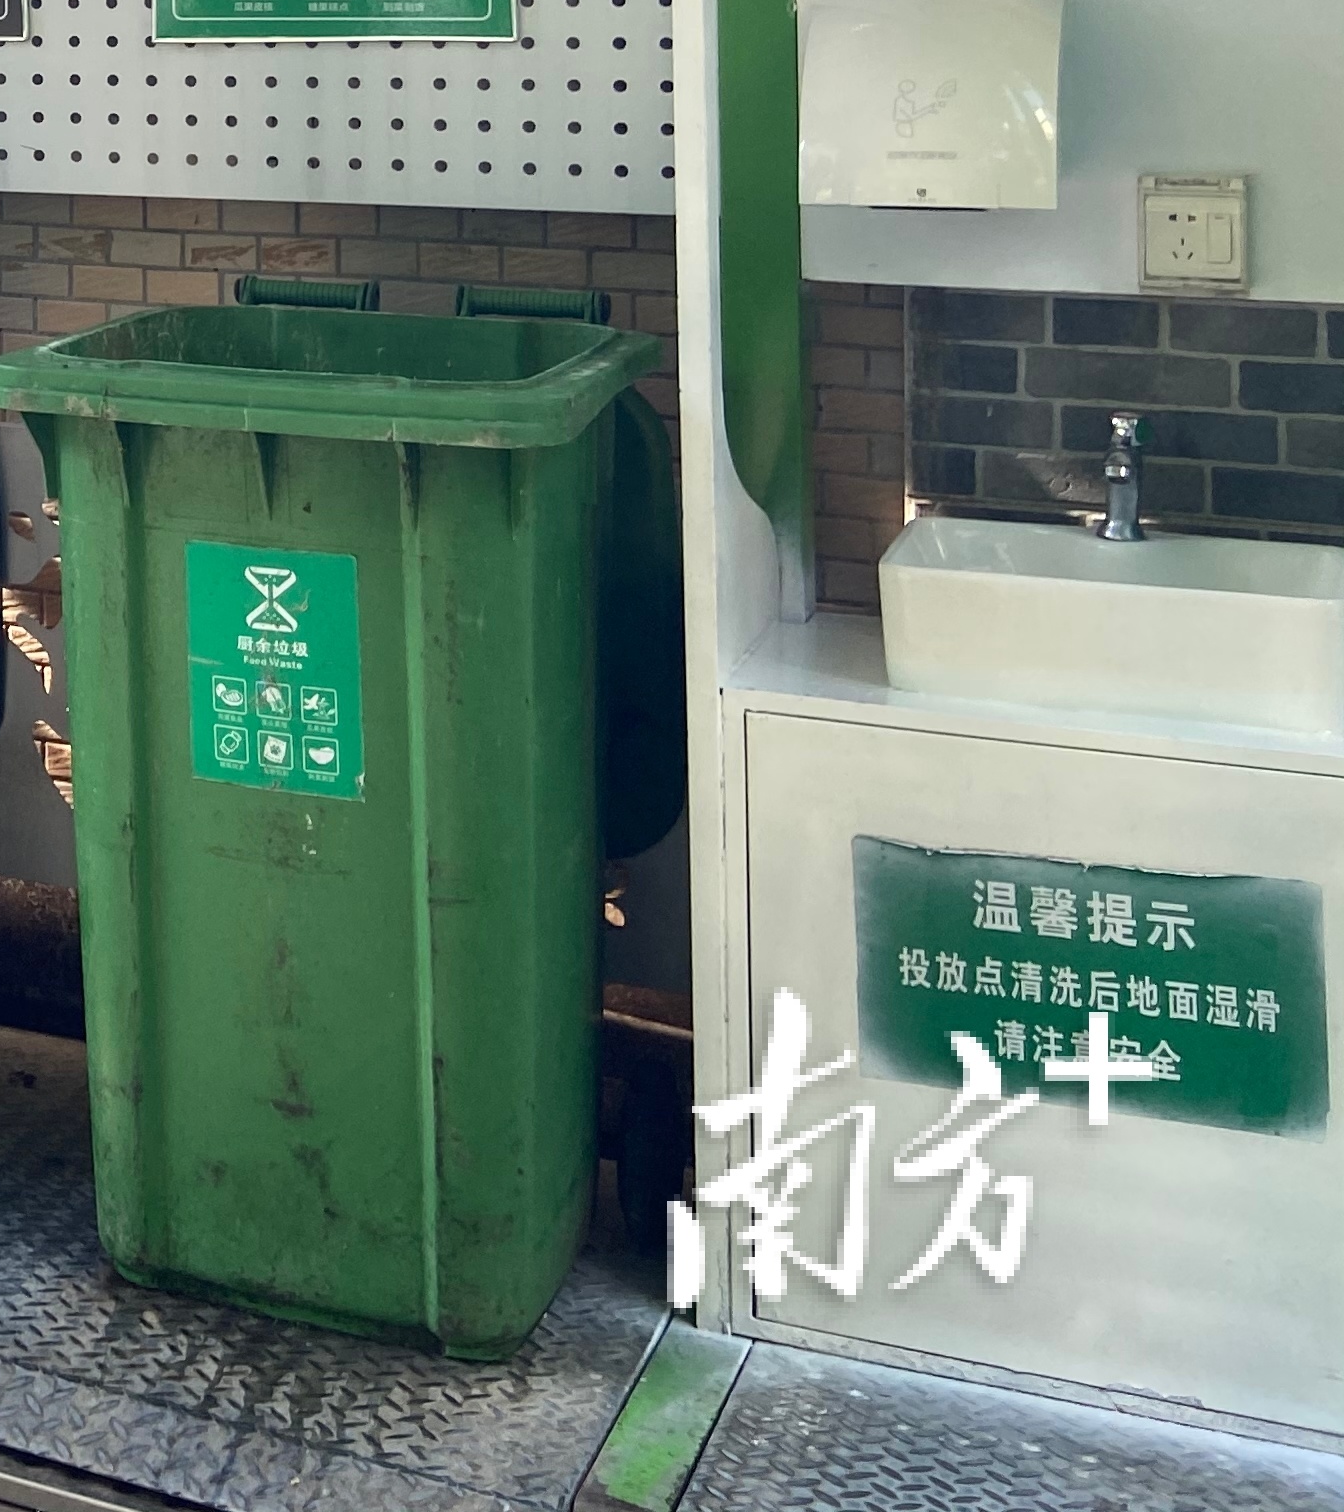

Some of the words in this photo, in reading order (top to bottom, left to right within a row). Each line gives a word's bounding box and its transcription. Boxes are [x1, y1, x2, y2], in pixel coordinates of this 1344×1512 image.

[237, 635, 309, 657] 厨余垃圾
[972, 878, 1199, 952] 温馨提示
[899, 946, 1281, 1034] 投放点清洗后地面湿滑
